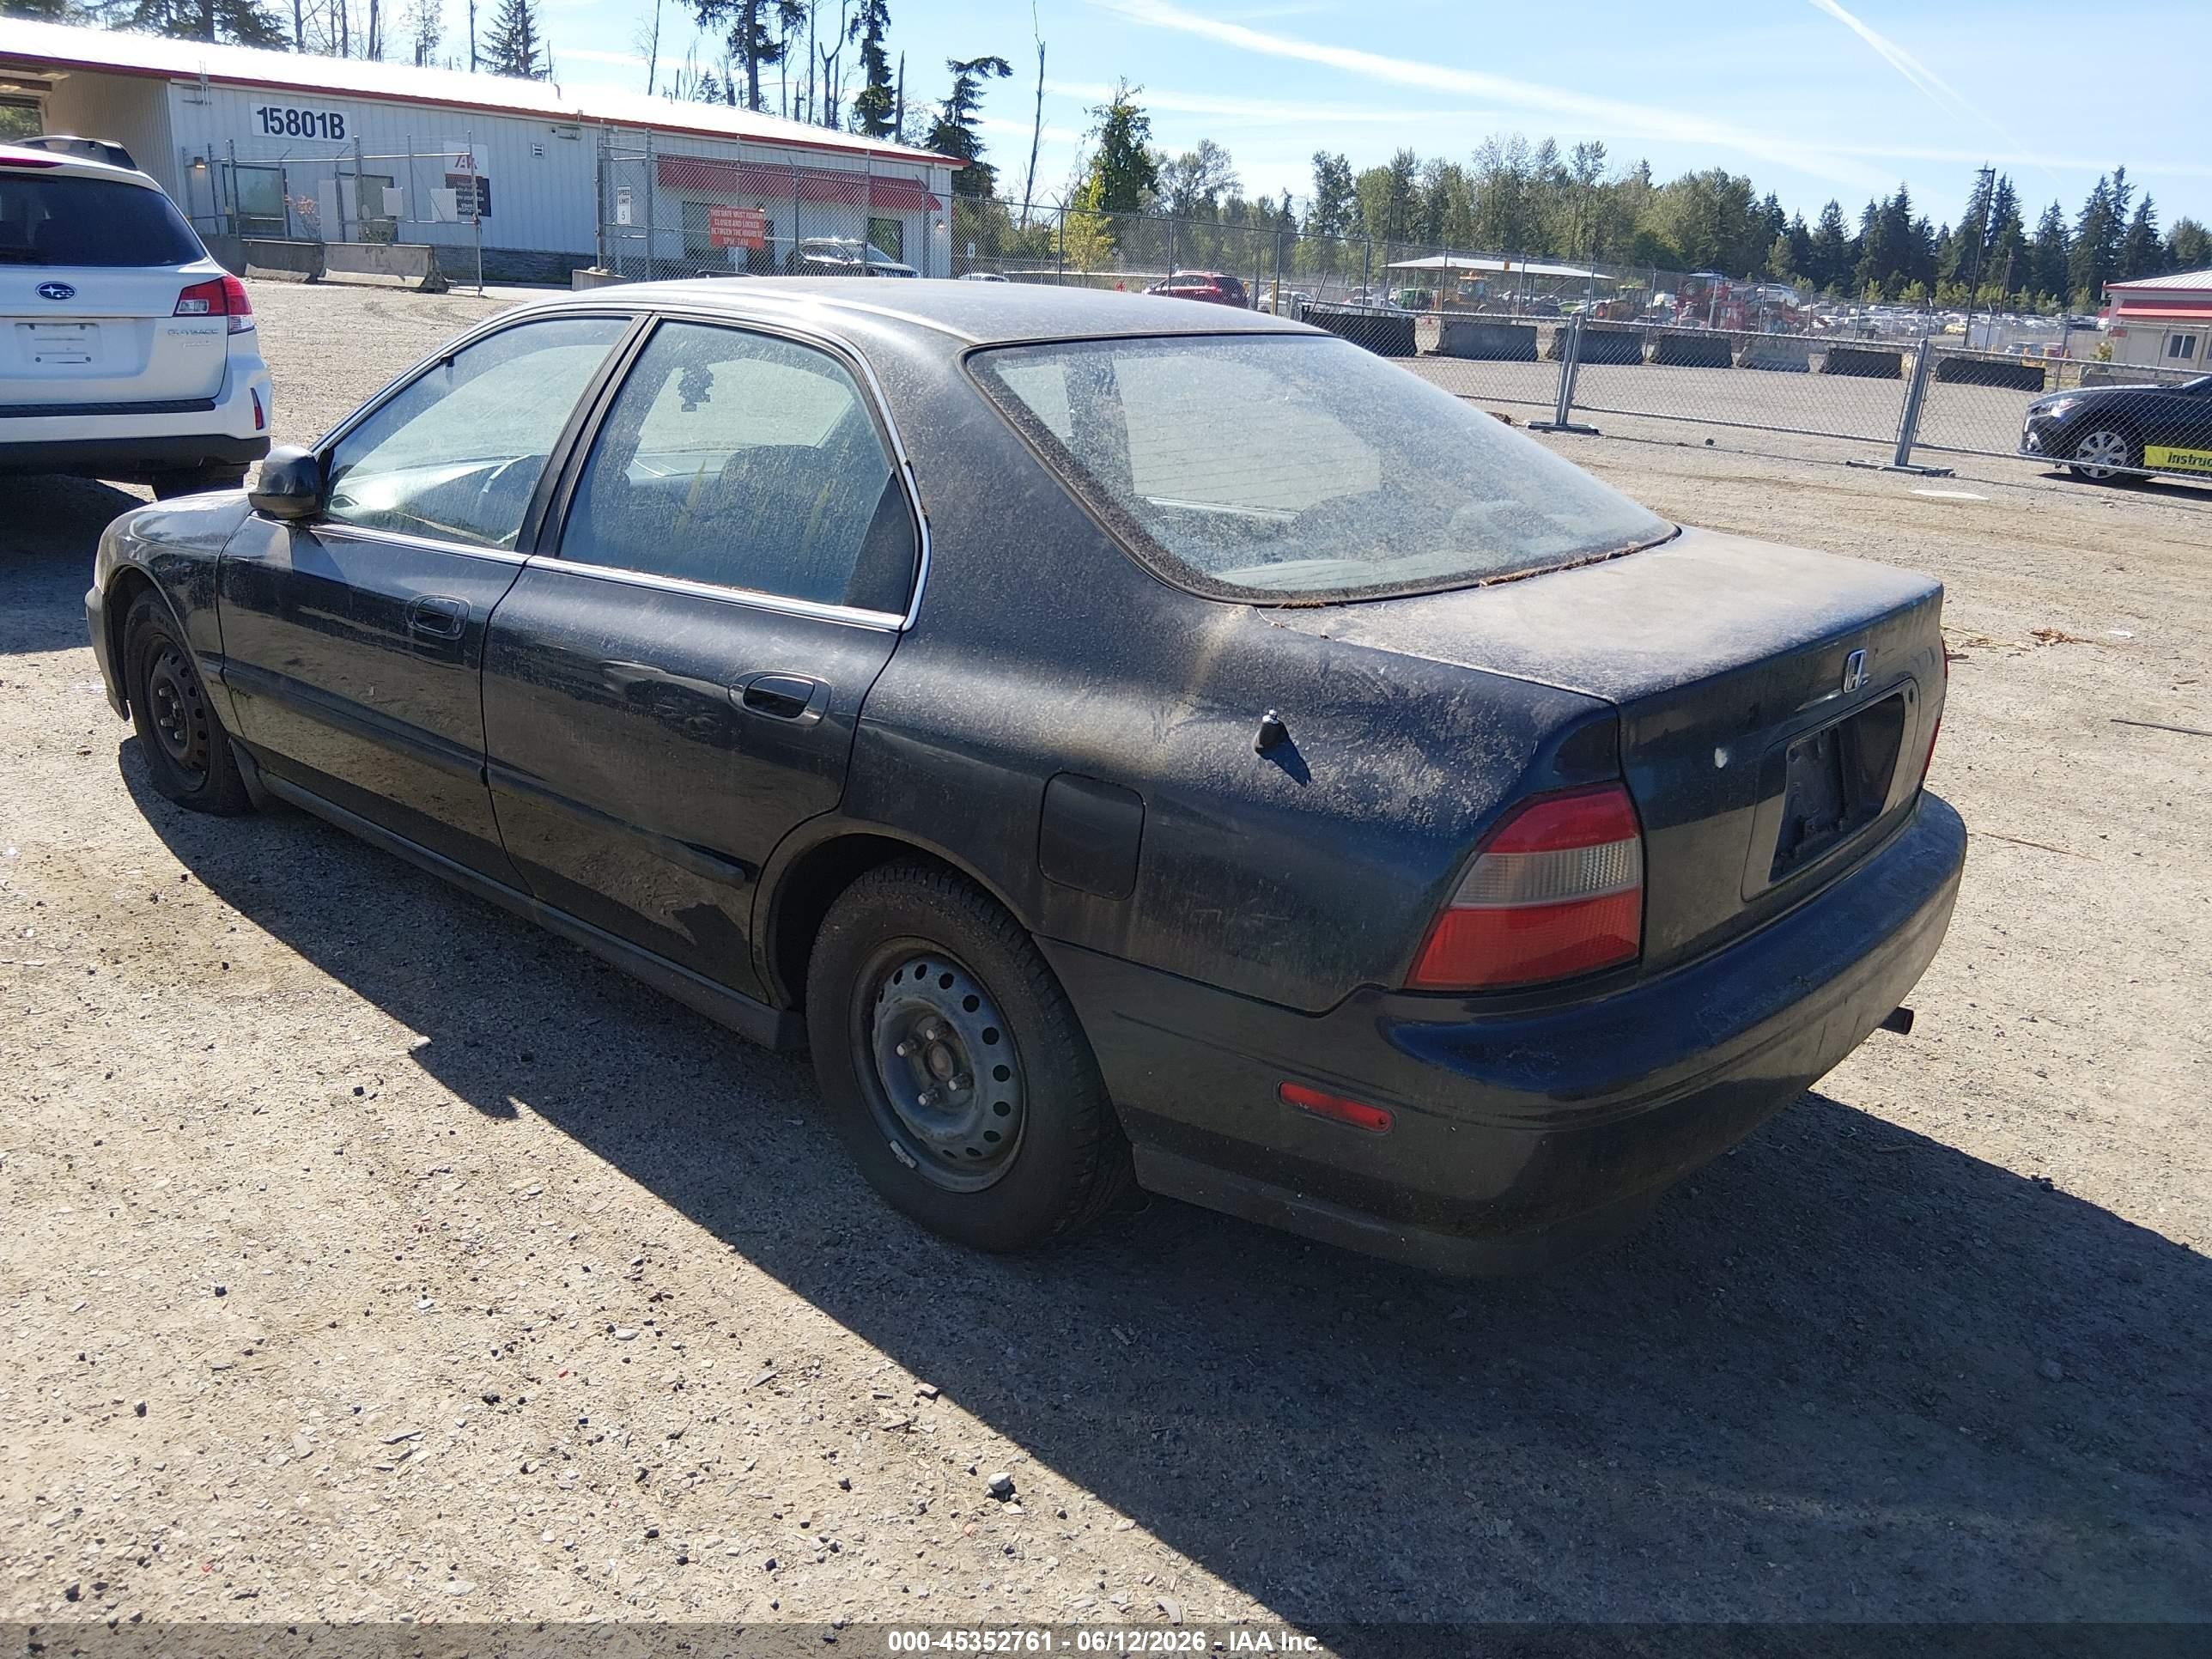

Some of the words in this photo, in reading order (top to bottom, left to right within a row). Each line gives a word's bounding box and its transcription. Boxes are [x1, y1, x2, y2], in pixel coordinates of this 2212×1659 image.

[256, 106, 345, 140] 15801B
[621, 210, 626, 220] 5
[710, 227, 732, 235] BETWEEN
